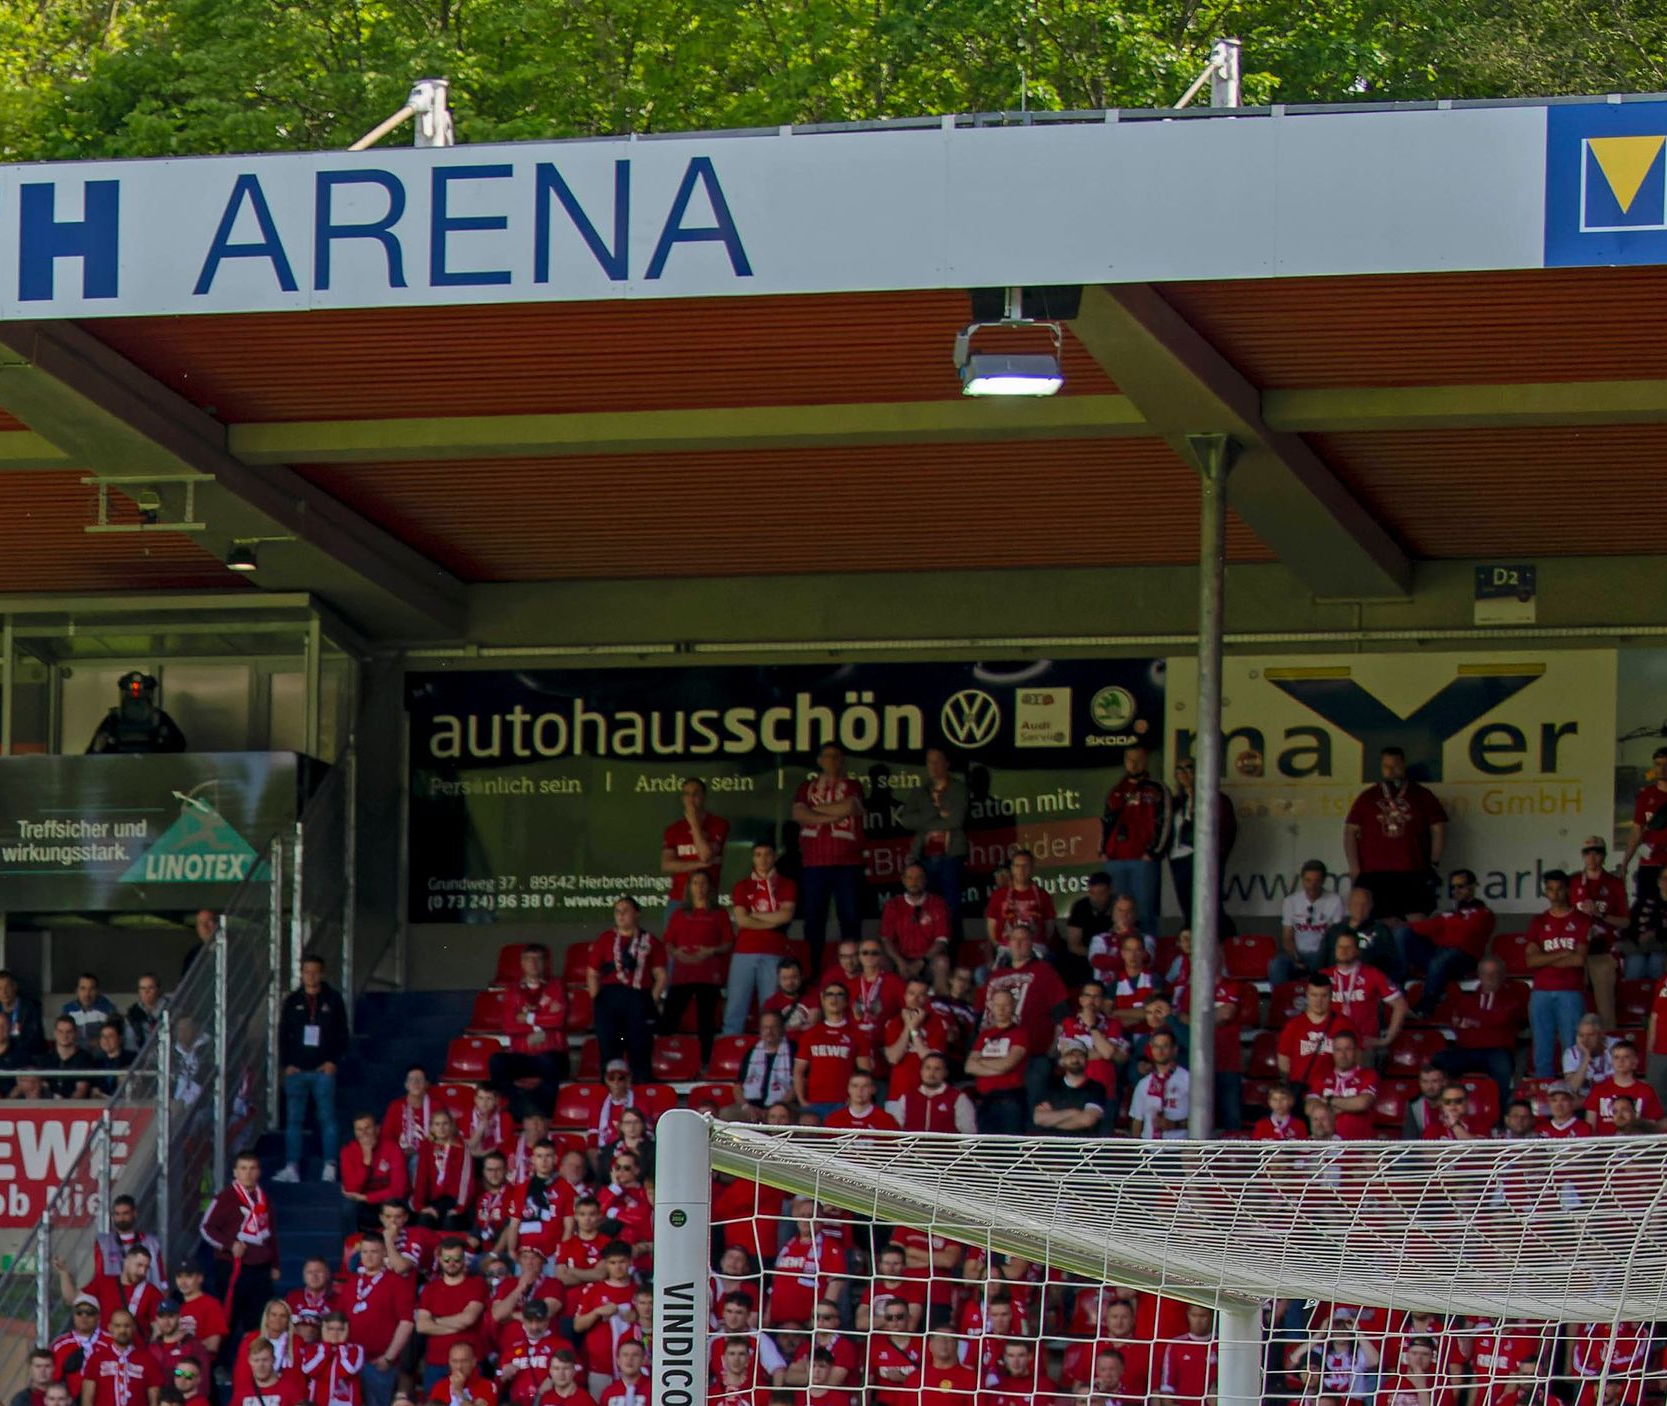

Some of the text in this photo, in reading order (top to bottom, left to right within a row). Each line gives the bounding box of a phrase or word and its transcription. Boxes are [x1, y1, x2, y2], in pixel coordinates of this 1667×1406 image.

[193, 156, 754, 297] ARENA
[1494, 568, 1519, 586] D2
[429, 693, 924, 758] autohausschön
[429, 773, 535, 797] Persönlich
[540, 776, 581, 794] sein
[714, 774, 754, 792] sein
[878, 771, 921, 788] sein
[1037, 788, 1081, 813] mit:
[1483, 787, 1583, 816] GmbH
[16, 818, 148, 841] Treffsicher und
[1, 841, 131, 866] wirkungsstark.
[145, 852, 246, 882] LINOTEX
[530, 876, 576, 889] 89542
[580, 876, 673, 891] Herbrechtinge
